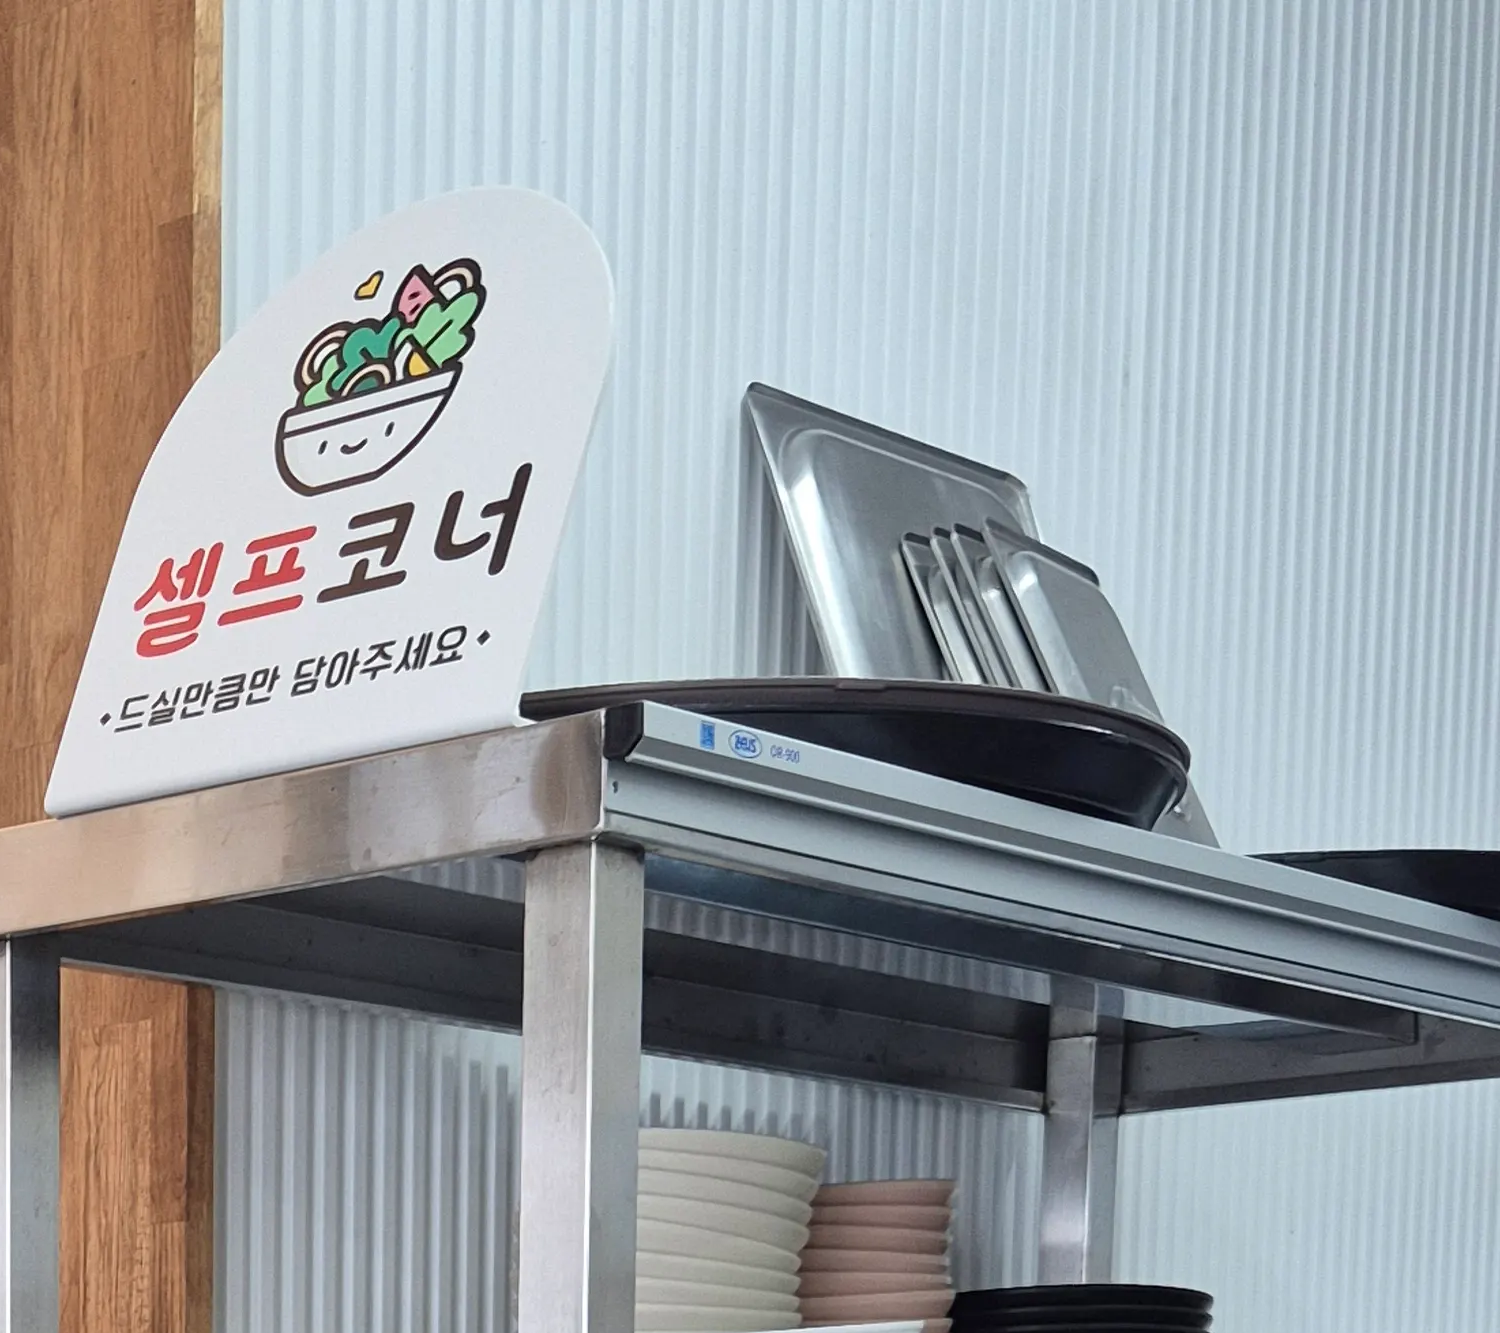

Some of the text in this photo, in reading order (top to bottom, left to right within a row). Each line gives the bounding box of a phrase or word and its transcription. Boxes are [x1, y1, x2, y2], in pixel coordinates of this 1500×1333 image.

[133, 461, 533, 658] 셀프코너
[113, 625, 467, 734] 드실만큼만 담아주세요
